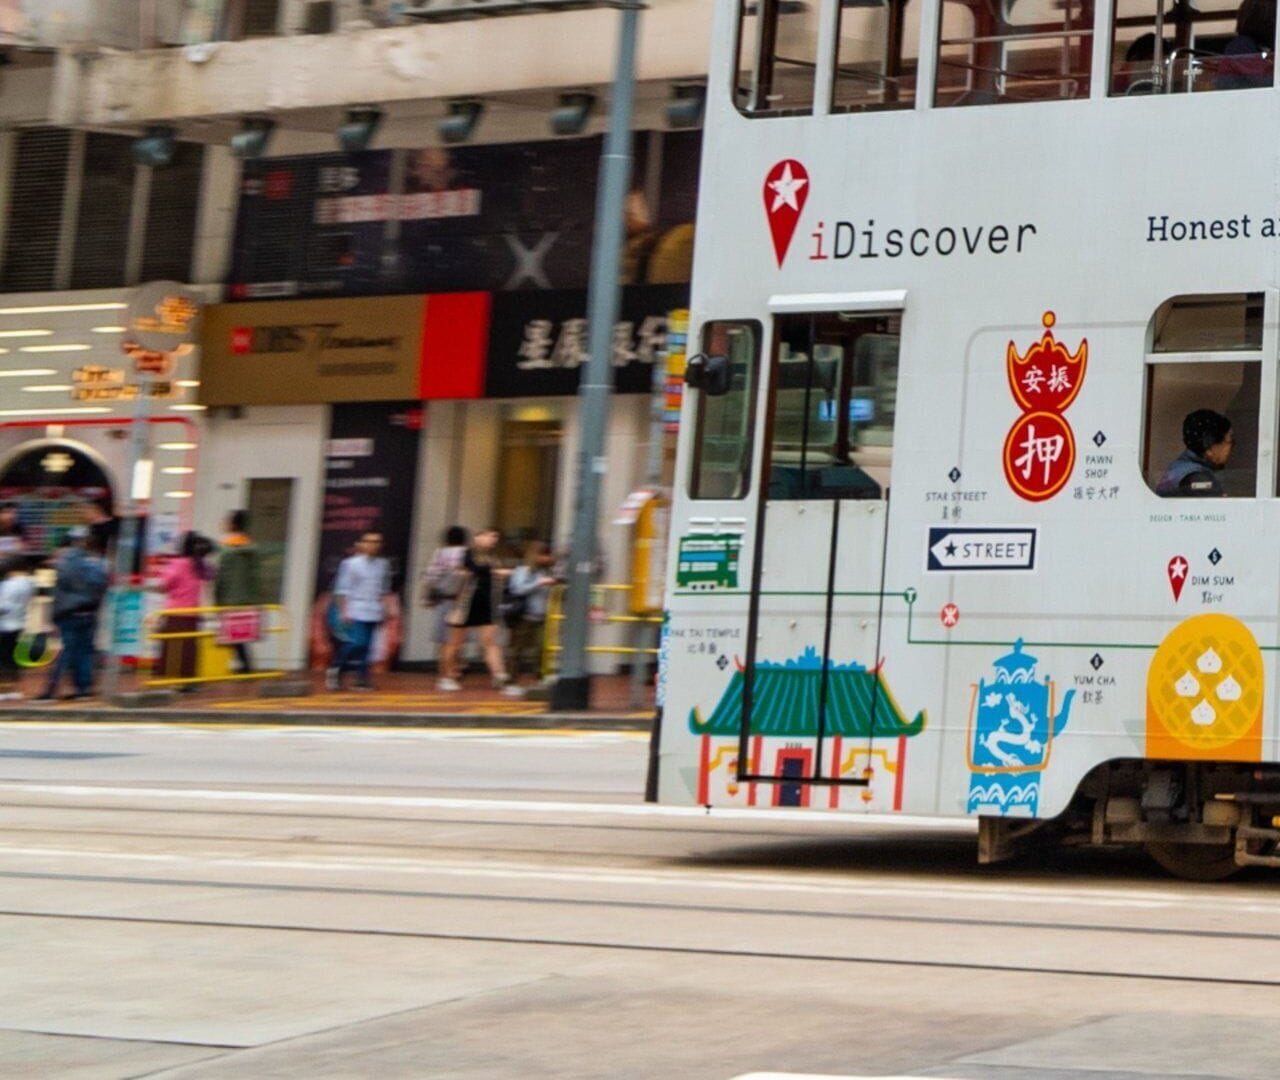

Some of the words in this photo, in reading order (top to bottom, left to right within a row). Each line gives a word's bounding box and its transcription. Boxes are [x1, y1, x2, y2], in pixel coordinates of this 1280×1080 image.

[1146, 213, 1252, 242] Honest
[809, 218, 1038, 261] iDiscover
[1015, 425, 1064, 485] 押
[1085, 455, 1113, 464] PAWN
[1085, 469, 1108, 478] SHOP
[926, 492, 948, 501] STAR
[951, 492, 988, 501] STREET
[962, 543, 1029, 559] STREET
[1192, 576, 1209, 586] DIM
[1213, 576, 1234, 586] SUM
[1074, 675, 1094, 686] YUM
[1096, 676, 1116, 687] CHA
